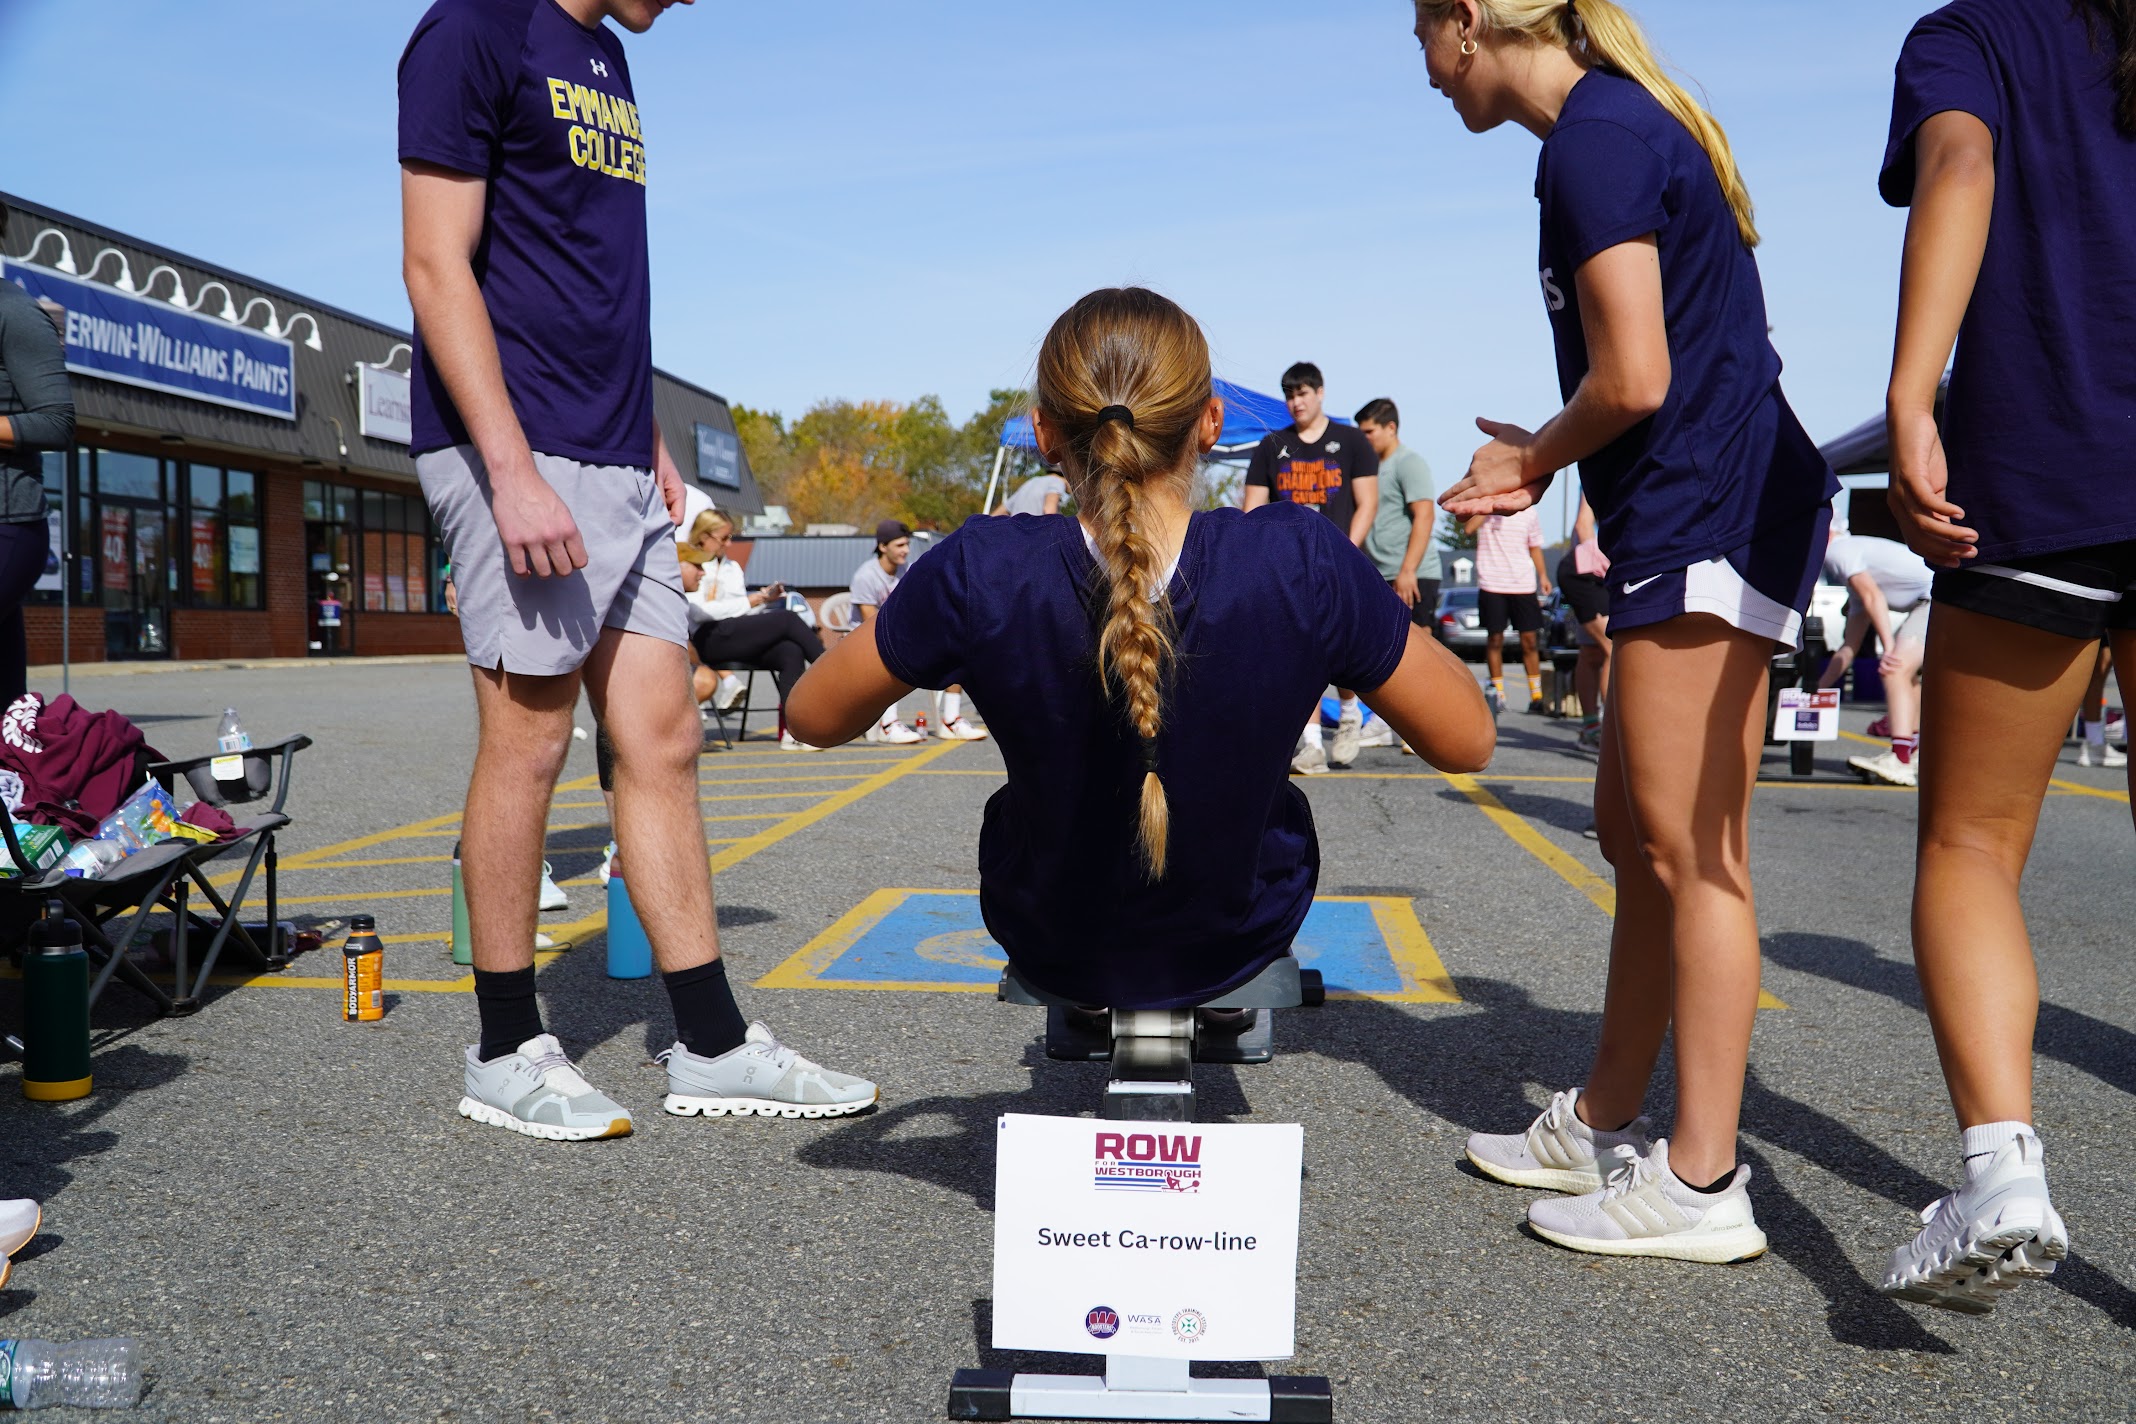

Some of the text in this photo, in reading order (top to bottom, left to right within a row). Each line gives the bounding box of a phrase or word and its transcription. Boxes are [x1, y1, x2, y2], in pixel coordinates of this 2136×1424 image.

[568, 125, 646, 187] COLLEGE
[1277, 468, 1342, 491] CHAMPIONS
[347, 957, 358, 1015] BODYARMOR
[1095, 1132, 1202, 1162] ROW
[1095, 1167, 1201, 1178] WESTBOROUGH
[1037, 1227, 1257, 1251] Sweet Ca-row-line
[1127, 1314, 1161, 1324] WASA
